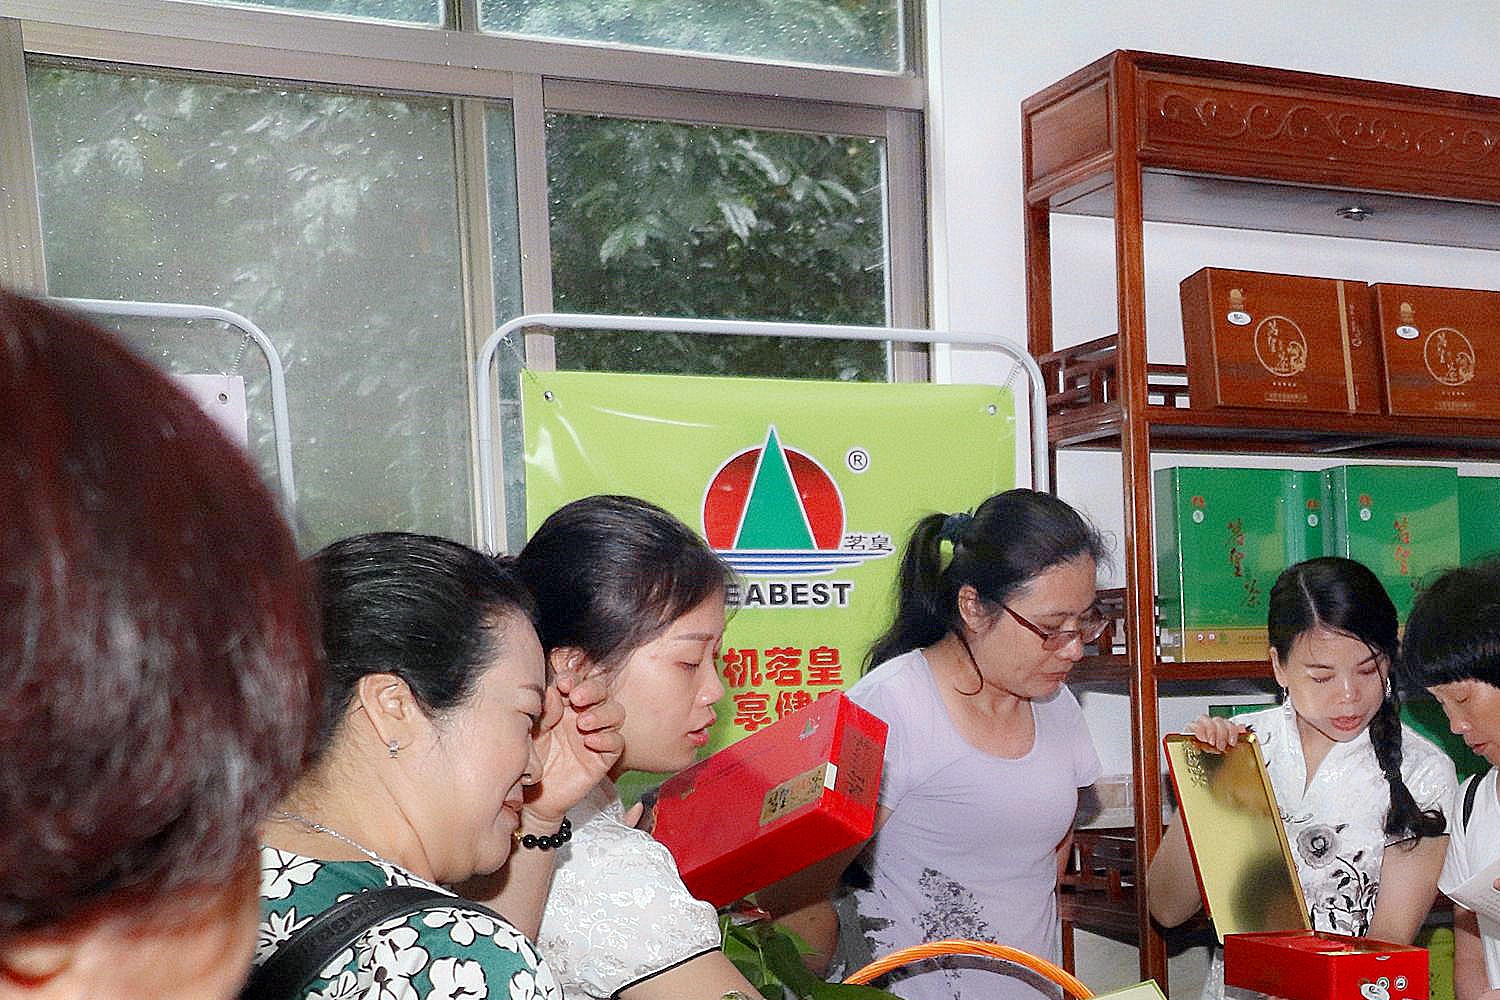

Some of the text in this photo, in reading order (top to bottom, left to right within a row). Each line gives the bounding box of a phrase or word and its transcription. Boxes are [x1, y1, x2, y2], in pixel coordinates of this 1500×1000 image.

[844, 533, 892, 553] 茗皇
[726, 582, 853, 607] EABEST
[733, 690, 842, 732] 享健
